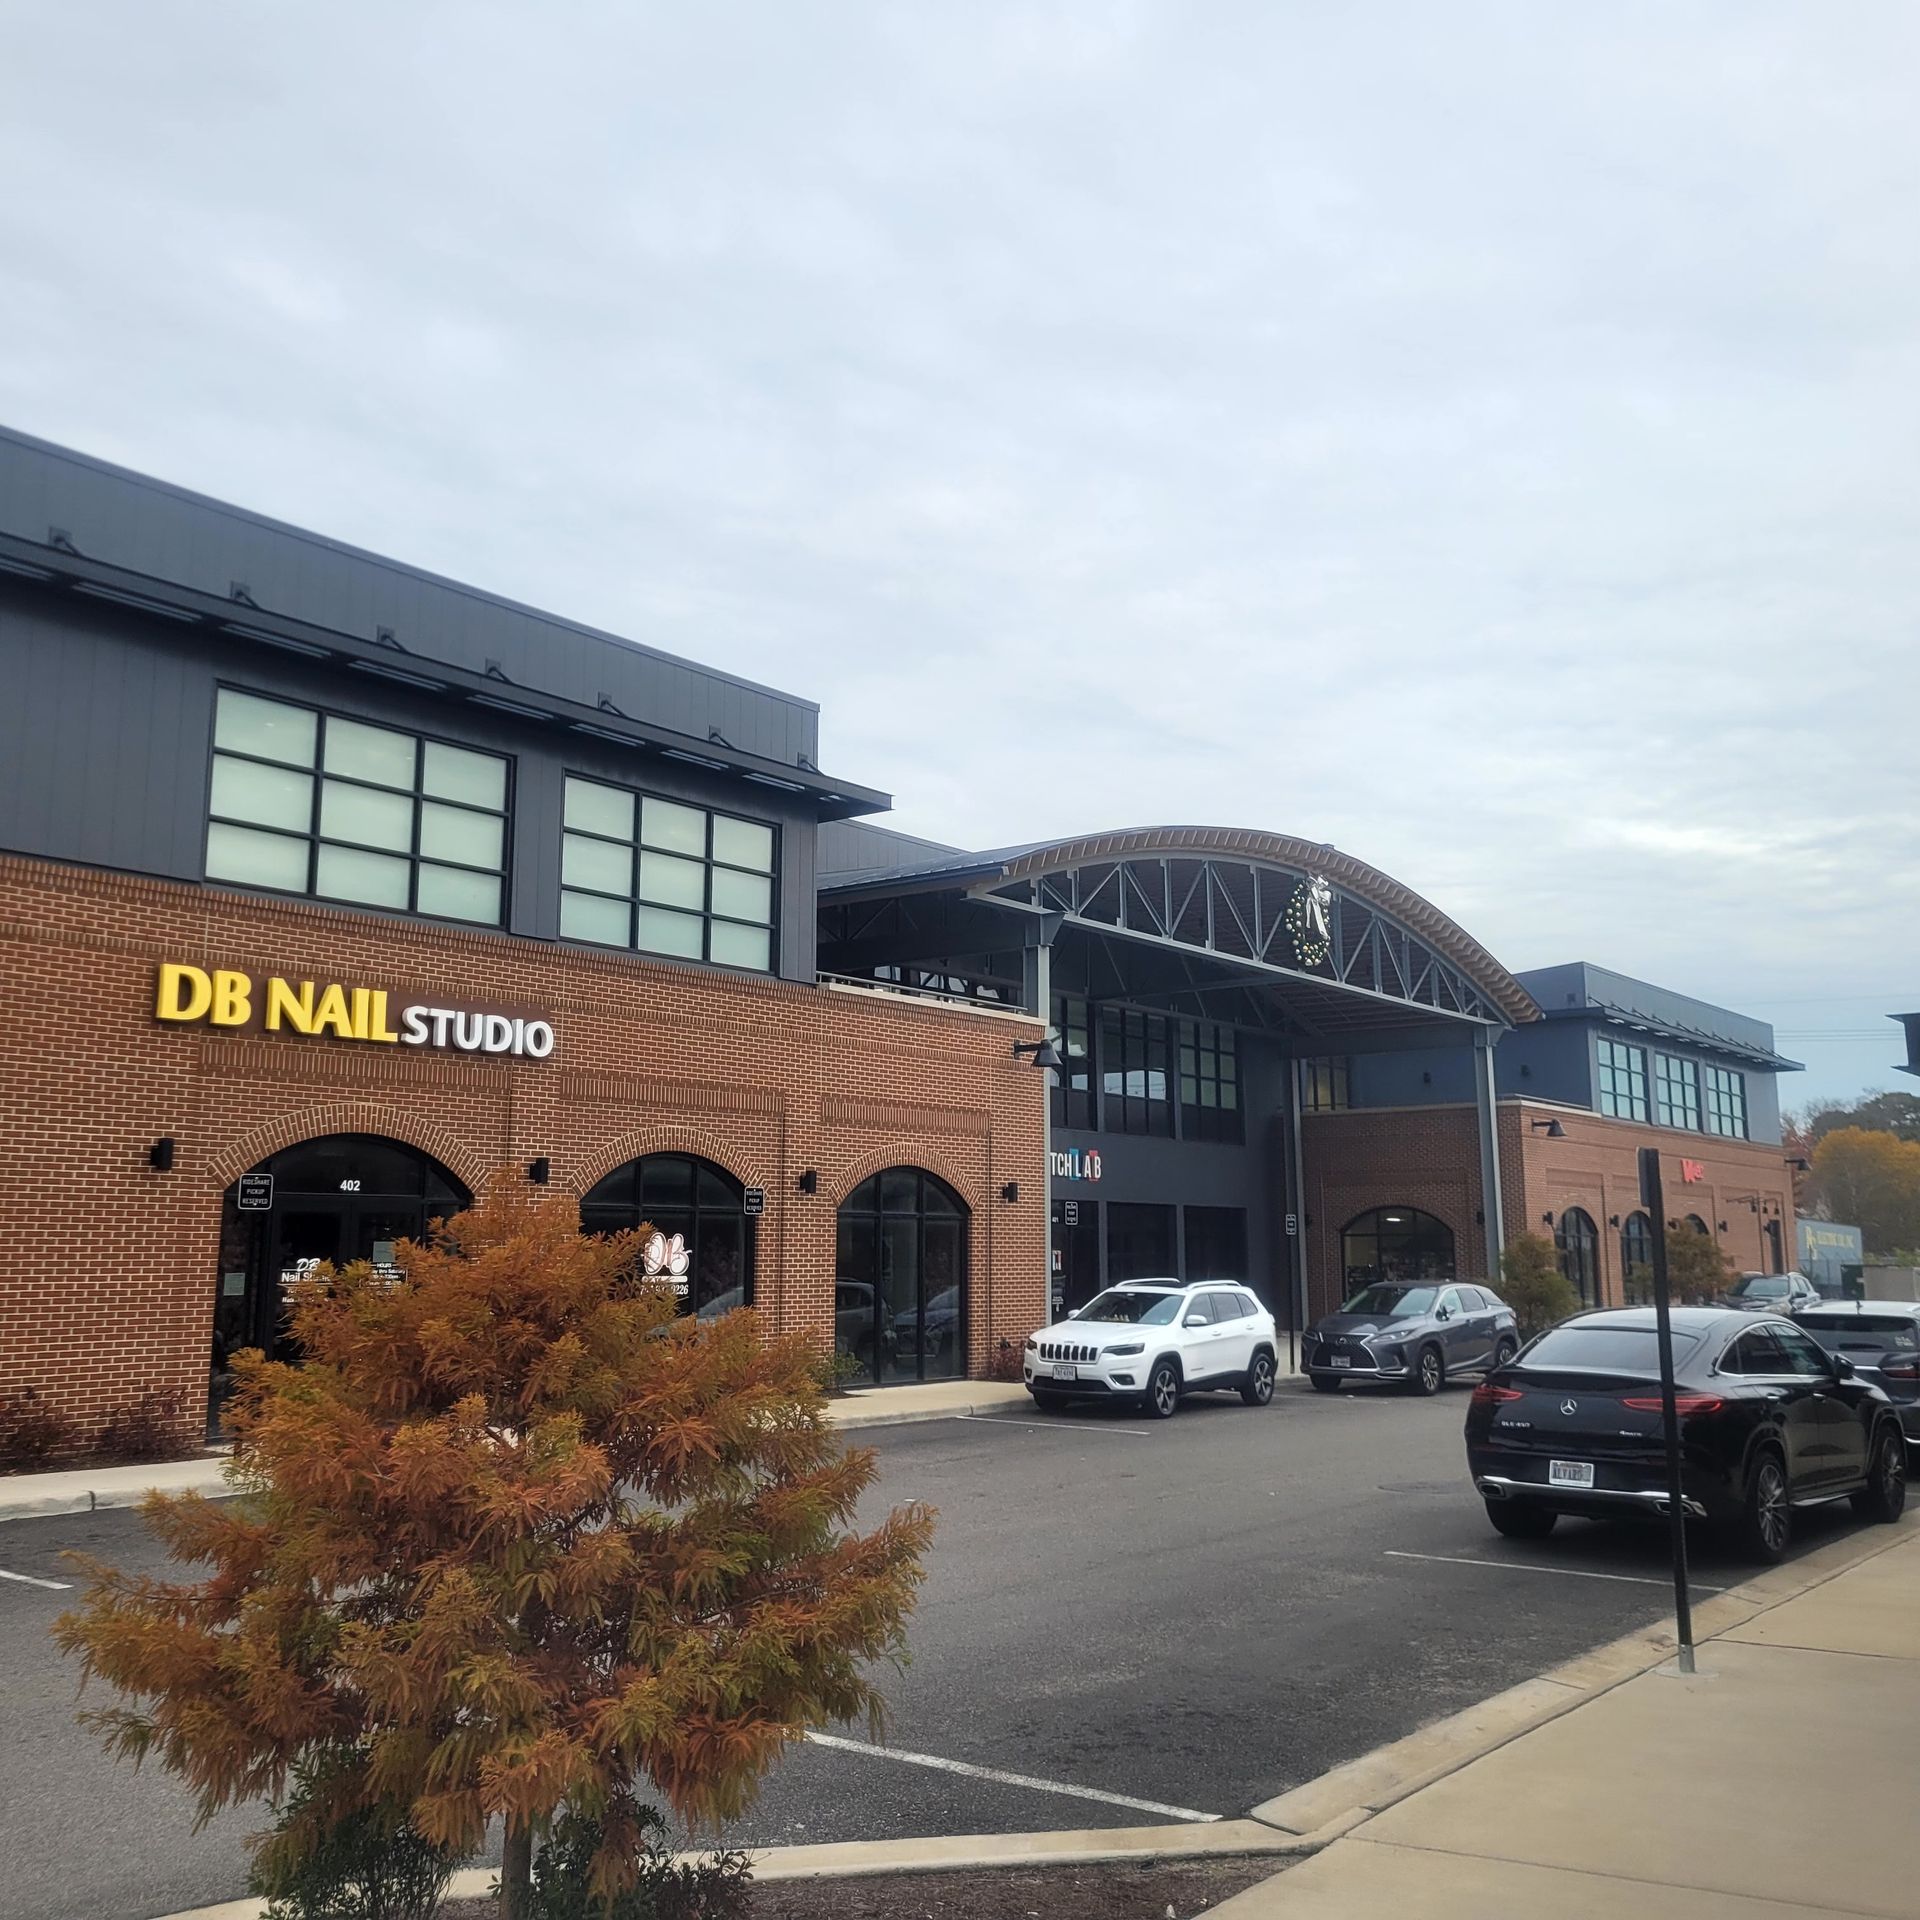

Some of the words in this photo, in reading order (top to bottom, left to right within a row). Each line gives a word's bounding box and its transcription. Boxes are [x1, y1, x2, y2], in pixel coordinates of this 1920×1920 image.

[156, 963, 252, 1026] DB
[265, 977, 399, 1043] NAIL
[402, 1005, 555, 1058] STUDIO
[340, 1180, 360, 1191] 402
[296, 1257, 320, 1272] DB
[281, 1271, 300, 1282] Nail
